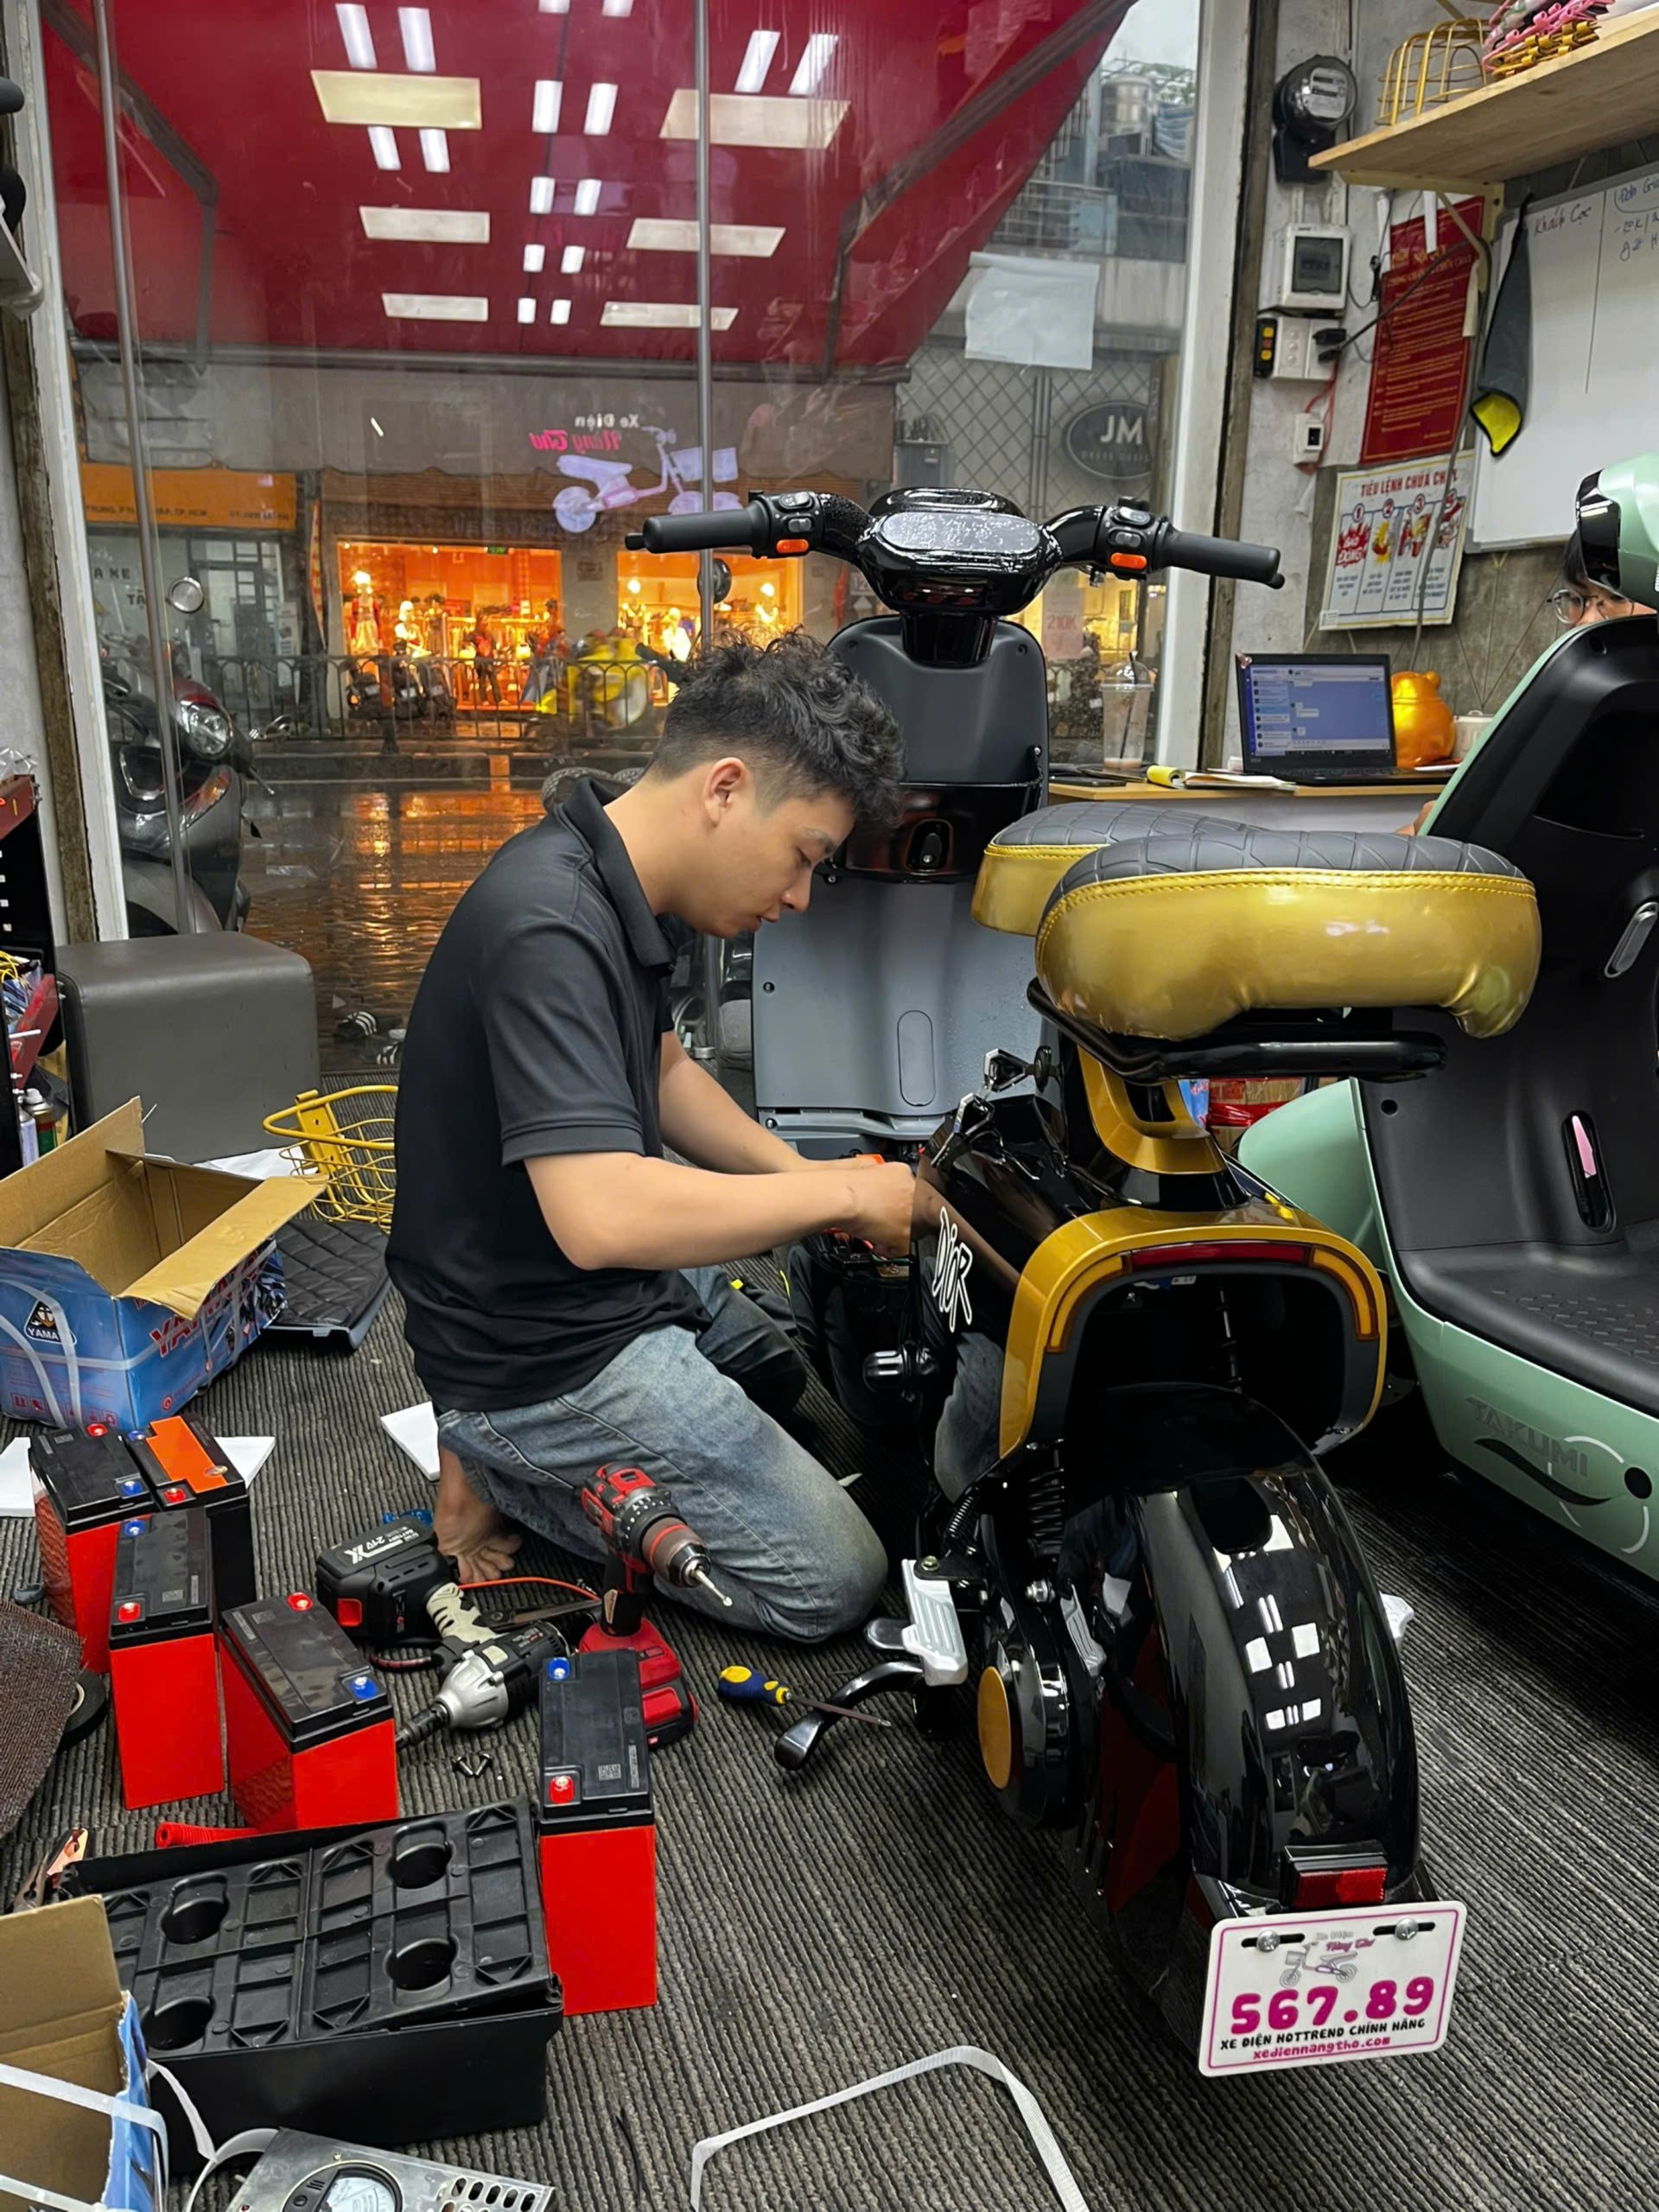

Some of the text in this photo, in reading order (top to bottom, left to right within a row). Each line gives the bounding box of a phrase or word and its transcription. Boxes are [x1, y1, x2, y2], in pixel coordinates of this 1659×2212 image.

[1100, 415, 1143, 444] JM
[1433, 468, 1459, 486] CHY
[109, 567, 131, 580] XE
[27, 1327, 60, 1341] YAMA
[1466, 1395, 1588, 1477] TAKUMI
[1220, 2038, 1236, 2050] XE
[1276, 2027, 1344, 2044] HOTTREND
[1350, 2021, 1388, 2036] CHÍNH
[1253, 2037, 1390, 2060] xediennangtho.com
